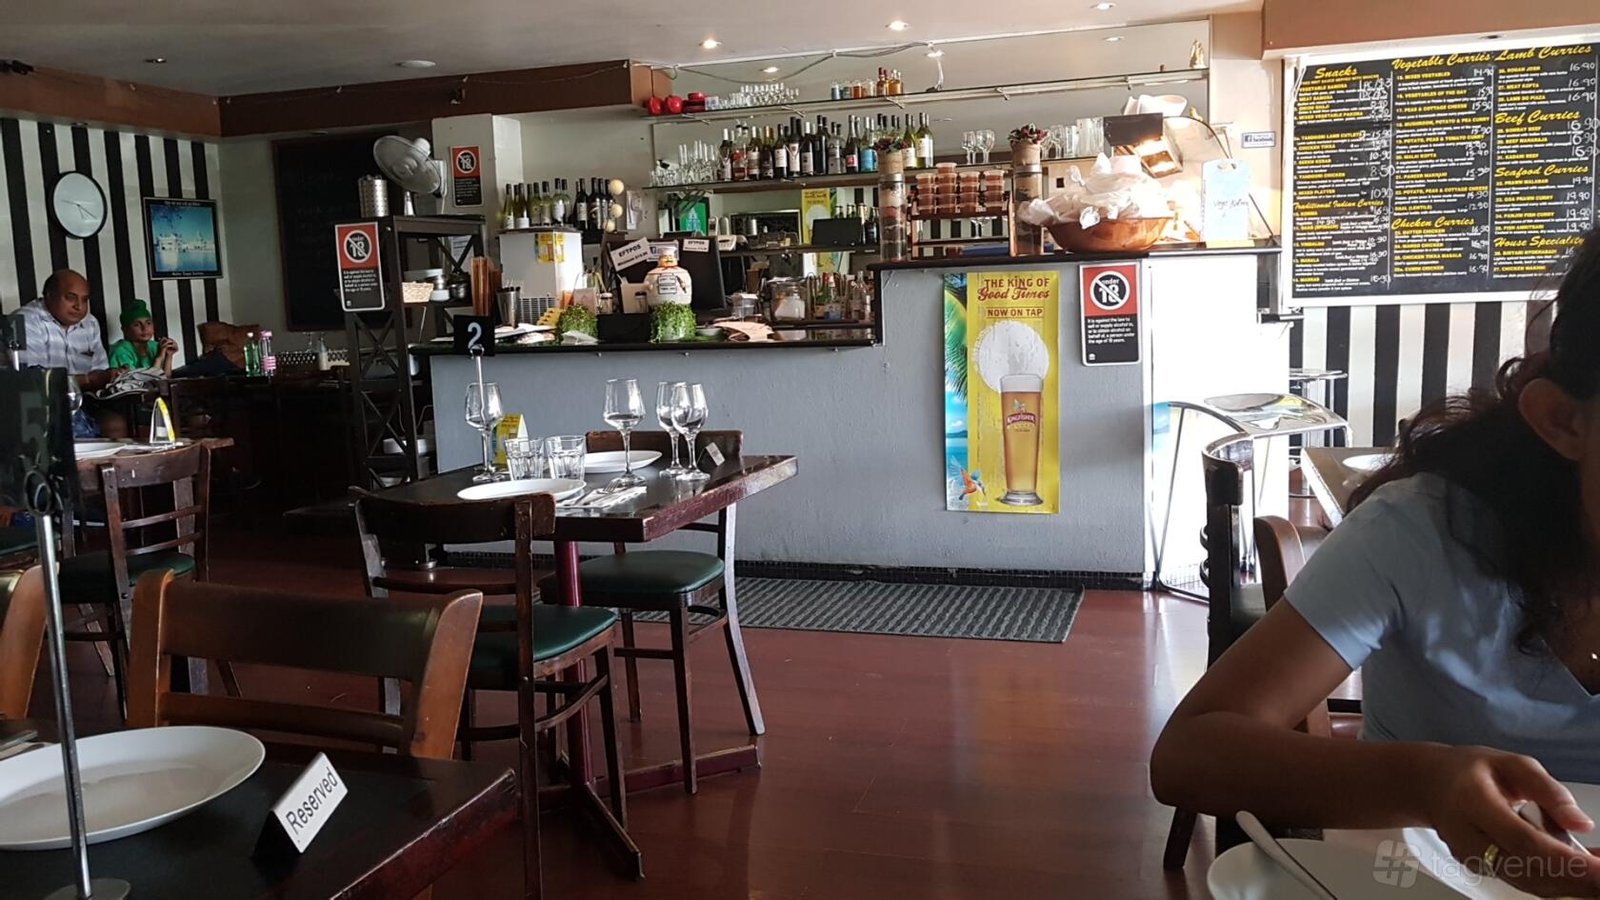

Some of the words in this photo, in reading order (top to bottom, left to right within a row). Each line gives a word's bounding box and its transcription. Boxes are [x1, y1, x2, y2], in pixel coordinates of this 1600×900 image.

[1494, 49, 1535, 61] Lamb
[1538, 45, 1592, 59] Curries
[1392, 56, 1444, 71] Vegetable
[1446, 53, 1491, 66] Curries
[1315, 65, 1357, 79] Snacks
[1494, 112, 1525, 126] Beef
[1528, 110, 1580, 124] Curries
[1494, 166, 1542, 178] Seafood
[1544, 164, 1588, 176] Curries
[1391, 218, 1432, 230] Chicken
[1434, 216, 1475, 228] Curries
[1494, 236, 1527, 248] House
[618, 244, 642, 257] EFTPOS
[984, 278, 1004, 290] THE
[1037, 278, 1050, 288] OF
[977, 287, 1010, 301] Good
[1012, 287, 1050, 300] Times
[1098, 284, 1120, 303] 18
[467, 322, 482, 349] 2
[286, 766, 338, 836] Reserved
